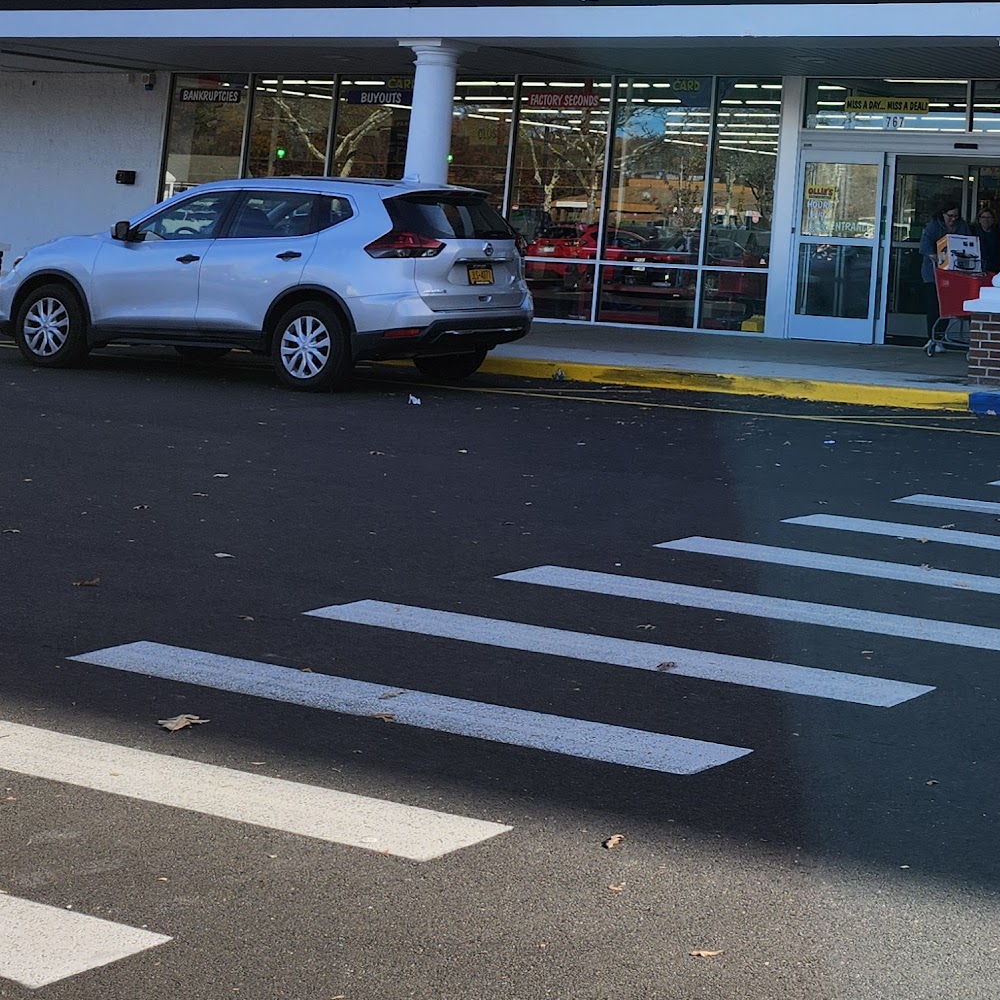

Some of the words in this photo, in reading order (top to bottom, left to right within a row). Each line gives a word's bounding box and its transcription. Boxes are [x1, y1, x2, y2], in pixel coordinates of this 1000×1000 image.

[672, 79, 701, 92] CARD
[182, 89, 239, 102] BANKRUPTCIES
[360, 91, 402, 104] BUYOUTS
[530, 93, 563, 106] FACTORY
[563, 94, 599, 107] SECONDS
[846, 100, 862, 110] MISS
[862, 101, 867, 110] A
[887, 102, 902, 111] MISS
[903, 102, 908, 111] A
[886, 116, 904, 128] 767
